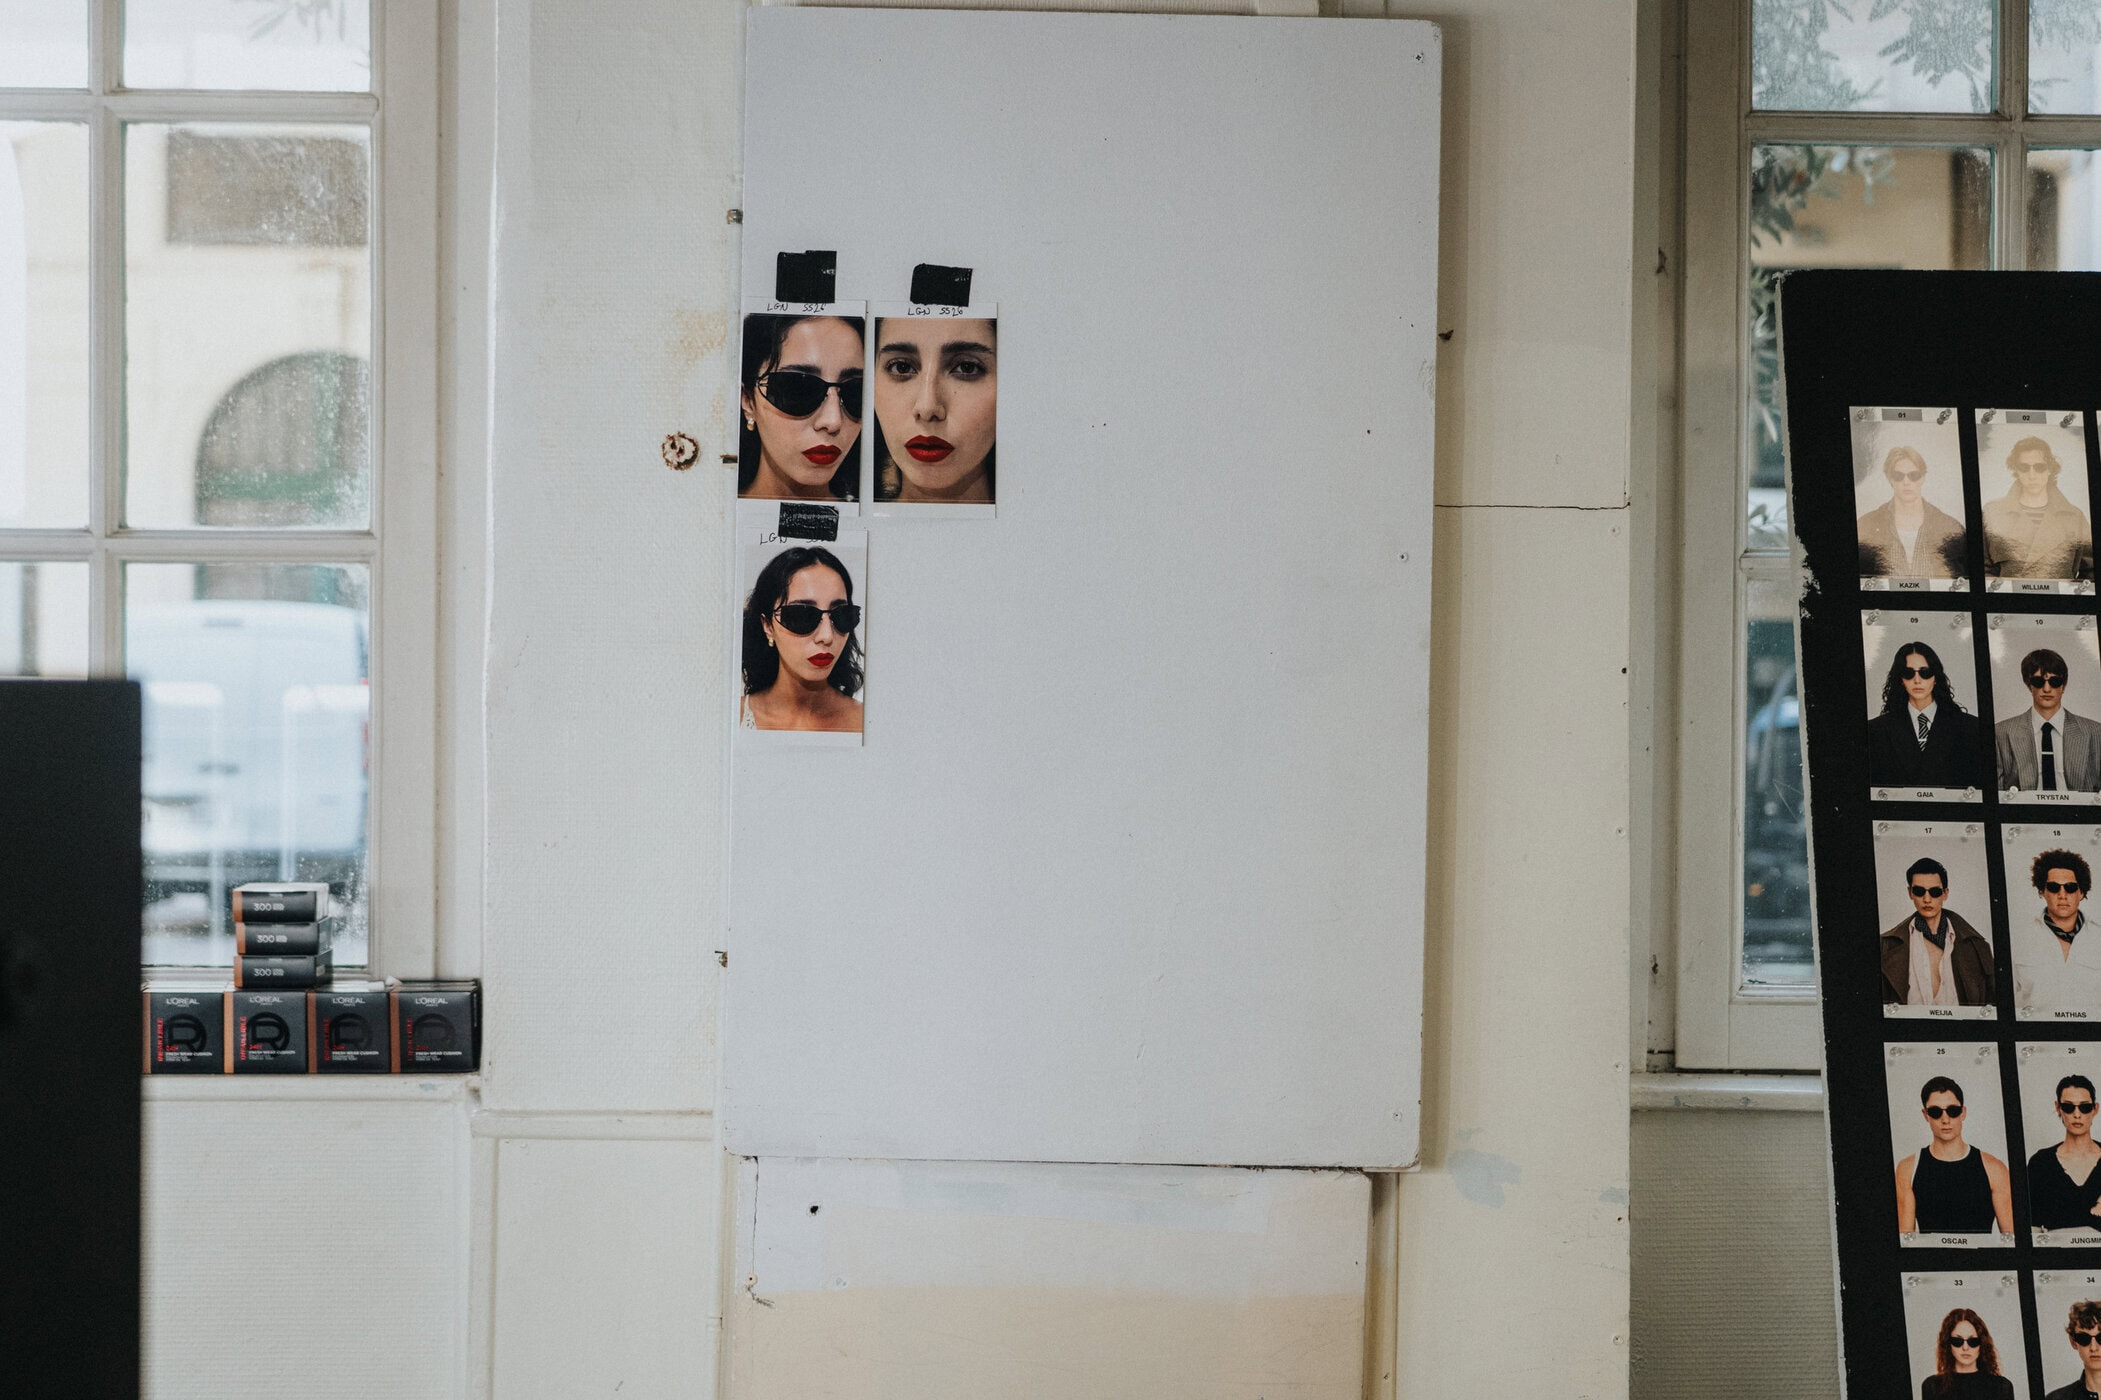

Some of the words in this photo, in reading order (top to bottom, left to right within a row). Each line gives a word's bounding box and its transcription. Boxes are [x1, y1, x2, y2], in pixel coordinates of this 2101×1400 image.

[766, 302, 789, 312] LGN
[907, 307, 931, 316] LGN
[939, 305, 964, 317] SS26
[2035, 618, 2044, 626] 10
[2052, 829, 2062, 837] 18
[253, 903, 272, 911] 300
[256, 934, 275, 943] 300
[253, 968, 272, 976] 300
[1929, 1009, 1954, 1017] WEIJIA
[2054, 1011, 2087, 1019] MATHIAS
[1936, 1047, 1946, 1055] 25
[2067, 1047, 2077, 1055] 26
[1940, 1237, 1968, 1245] OSCAR
[1954, 1279, 1964, 1287] 33
[2086, 1276, 2096, 1284] 34
